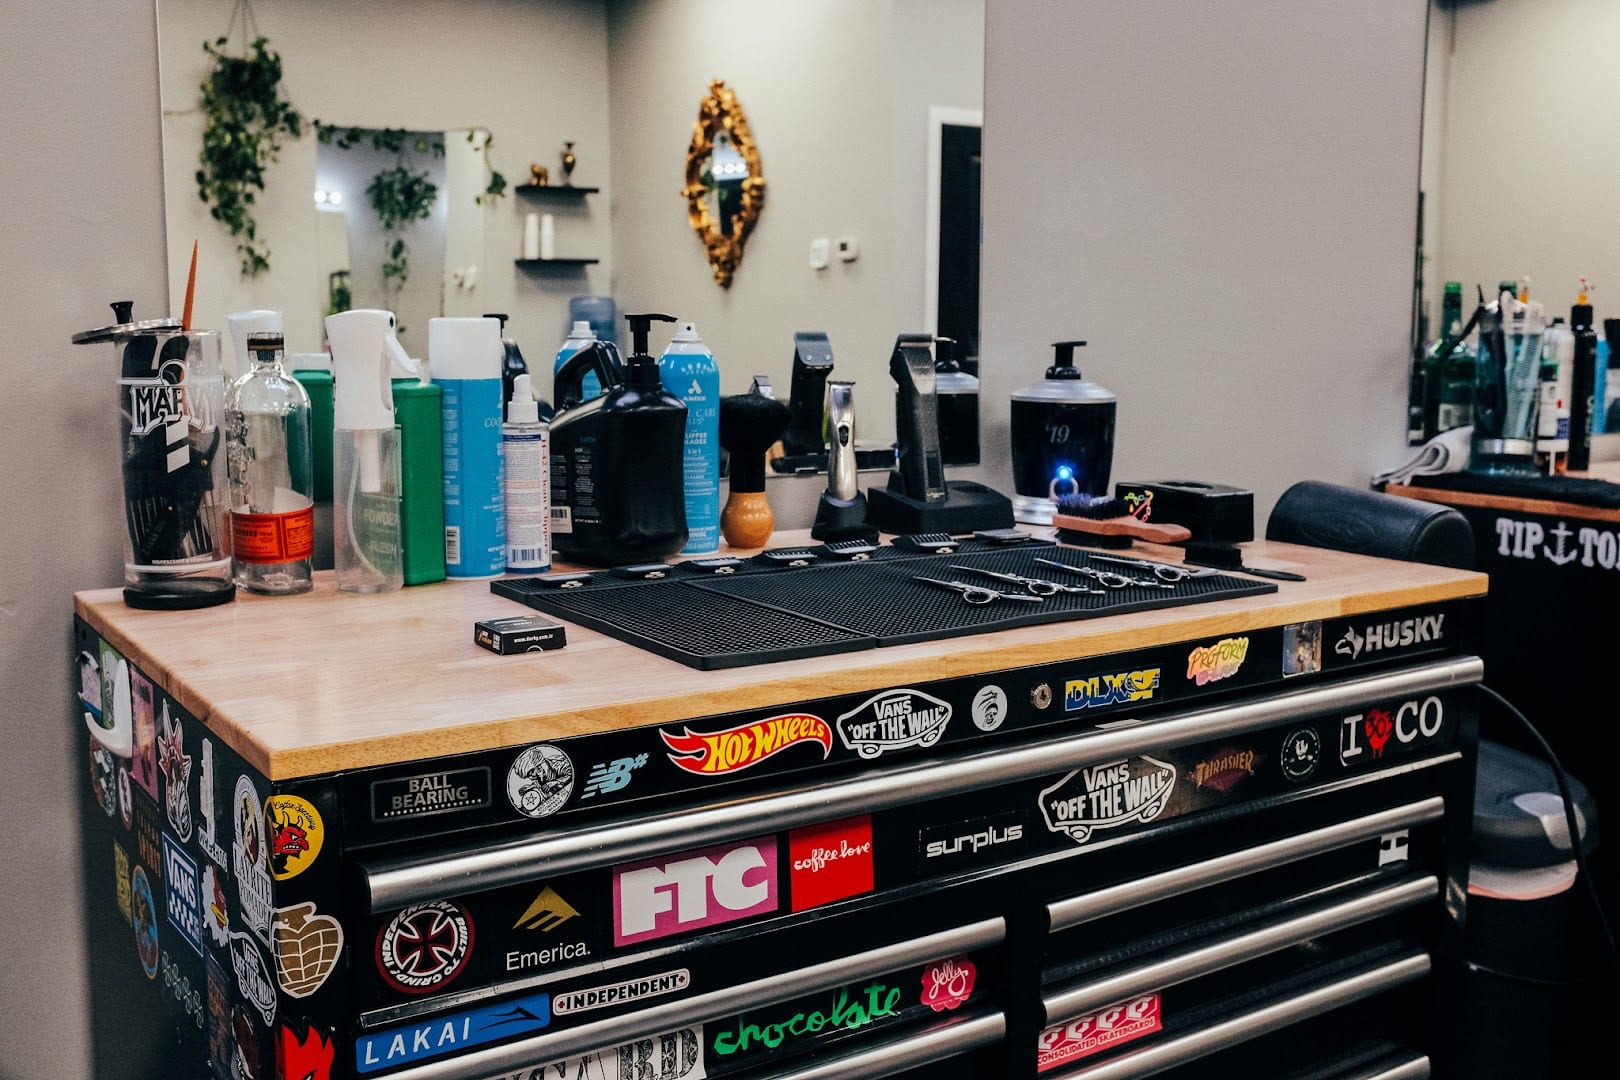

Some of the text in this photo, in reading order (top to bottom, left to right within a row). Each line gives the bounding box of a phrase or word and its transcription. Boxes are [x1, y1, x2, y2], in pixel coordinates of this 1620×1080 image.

[1496, 517, 1545, 559] TIP
[1365, 613, 1445, 652] HUSKY
[873, 695, 912, 720] VANS
[878, 715, 907, 740] THE
[1342, 714, 1364, 758] I
[1395, 696, 1443, 743] CO
[700, 732, 753, 772] HOT
[1196, 750, 1254, 788] THRASHER
[408, 776, 453, 794] BALL
[1083, 759, 1130, 792] VANS
[391, 786, 469, 811] BEARING
[1088, 784, 1124, 819] THE
[794, 840, 871, 872] coffee love
[926, 824, 1023, 858] surplus
[164, 841, 196, 909] VANS
[619, 845, 769, 938] FTC
[455, 916, 468, 957] BUILT
[565, 974, 679, 1010] INDEPENDENT
[928, 959, 970, 1000] Jelly
[714, 980, 902, 1055] chocolate
[1098, 1017, 1155, 1044] SKATEBOARDS
[365, 1016, 470, 1065] LAKAI
